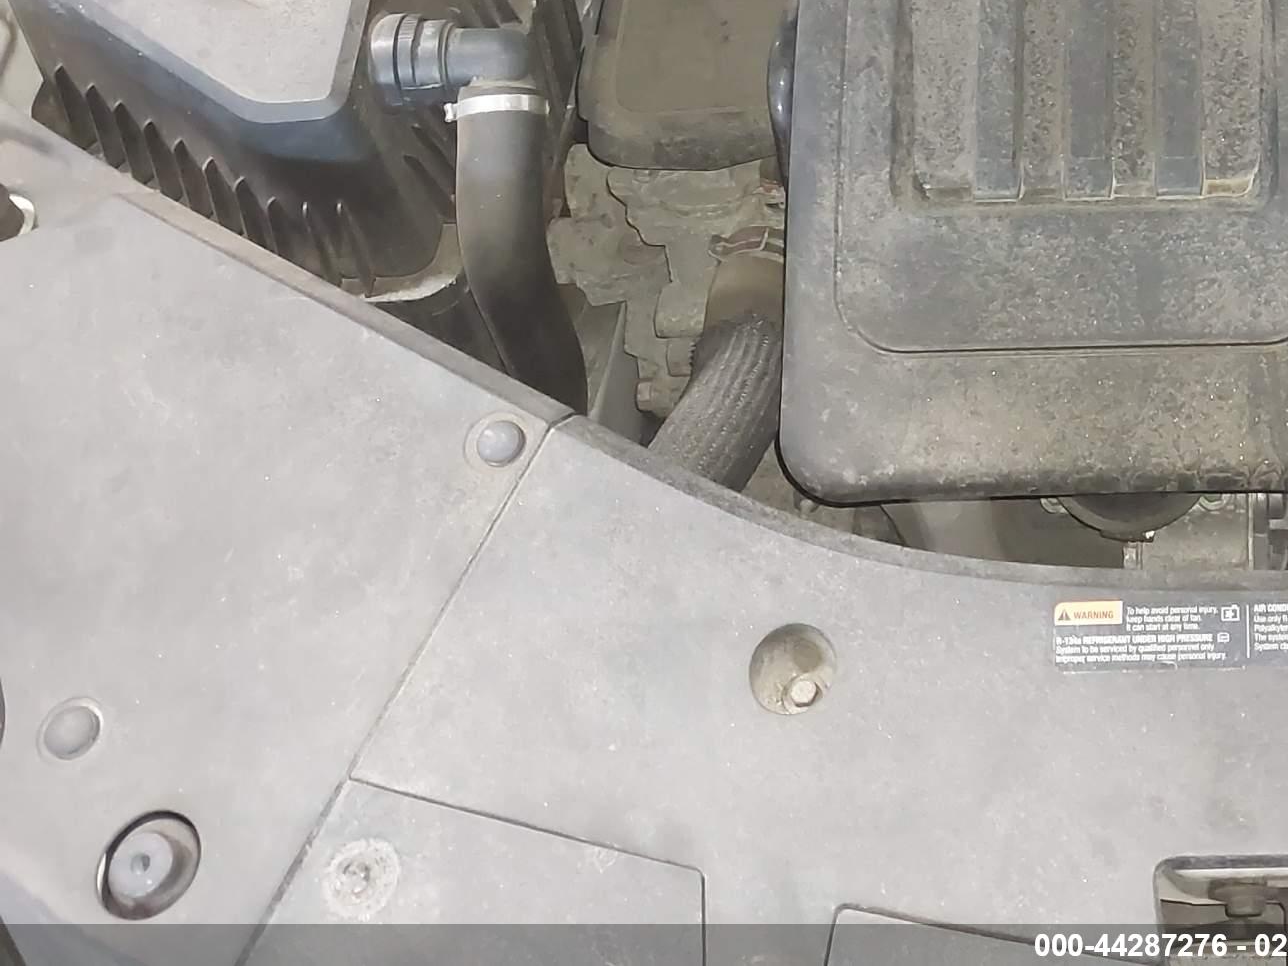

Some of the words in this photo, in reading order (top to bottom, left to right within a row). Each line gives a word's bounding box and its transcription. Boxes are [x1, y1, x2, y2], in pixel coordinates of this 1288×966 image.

[1126, 606, 1135, 615] To
[1135, 606, 1150, 616] help
[1151, 606, 1168, 614] avoid
[1170, 606, 1197, 615] personal
[1254, 603, 1266, 612] AIR
[1073, 610, 1114, 619] WARNING
[1144, 615, 1164, 623] hands
[1182, 614, 1189, 622] of
[1254, 615, 1266, 623] Use
[1267, 614, 1281, 624] only
[1170, 624, 1182, 632] any
[1082, 635, 1131, 644] REFRIGERANT
[1132, 634, 1157, 644] UNDER
[1158, 634, 1175, 643] HIGH
[1176, 633, 1213, 643] PRESSURE
[1254, 633, 1267, 641] The
[1056, 646, 1081, 655] System
[1081, 646, 1088, 654] to
[1090, 645, 1099, 653] be
[1100, 645, 1127, 653] serviced
[1129, 645, 1137, 654] by
[1138, 644, 1166, 653] qualified
[1167, 644, 1199, 652] personnel
[1254, 643, 1279, 652] System
[1178, 653, 1206, 661] personal
